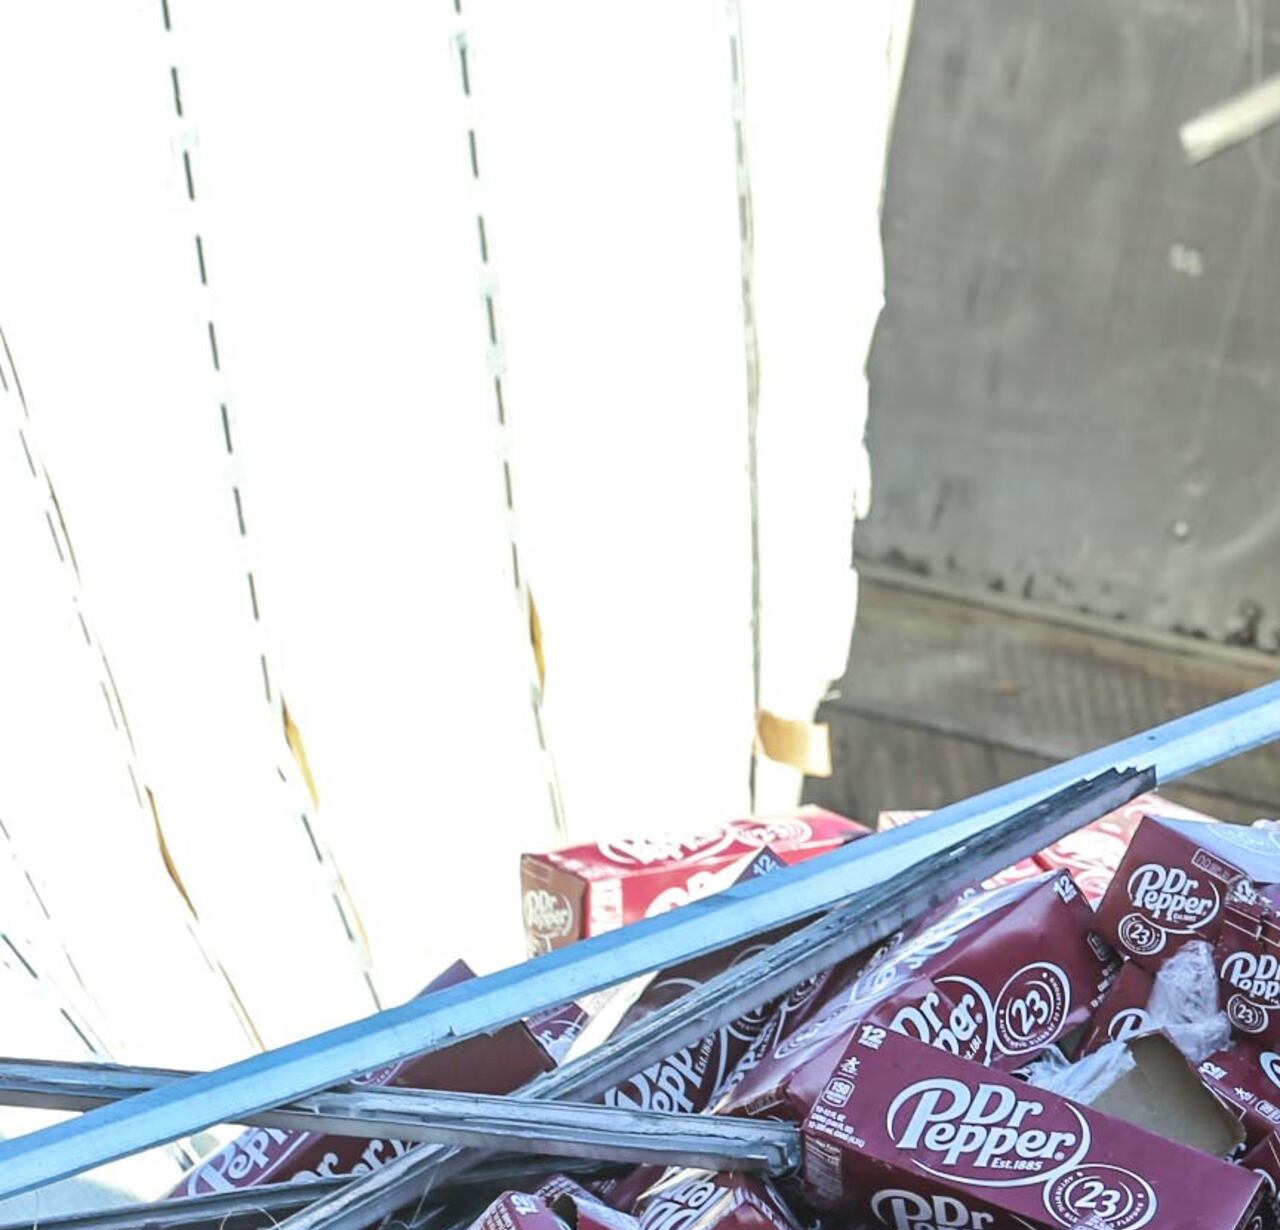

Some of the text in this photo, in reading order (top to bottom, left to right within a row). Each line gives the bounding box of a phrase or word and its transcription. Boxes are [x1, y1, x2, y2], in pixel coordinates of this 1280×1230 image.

[1129, 864, 1214, 917] Pepper
[1159, 870, 1200, 901] Dr
[861, 1024, 886, 1043] 12
[829, 1080, 849, 1095] 150
[965, 1083, 1041, 1126] Dr
[888, 1079, 1076, 1167] Pepper
[990, 1157, 1043, 1172] Est.1885
